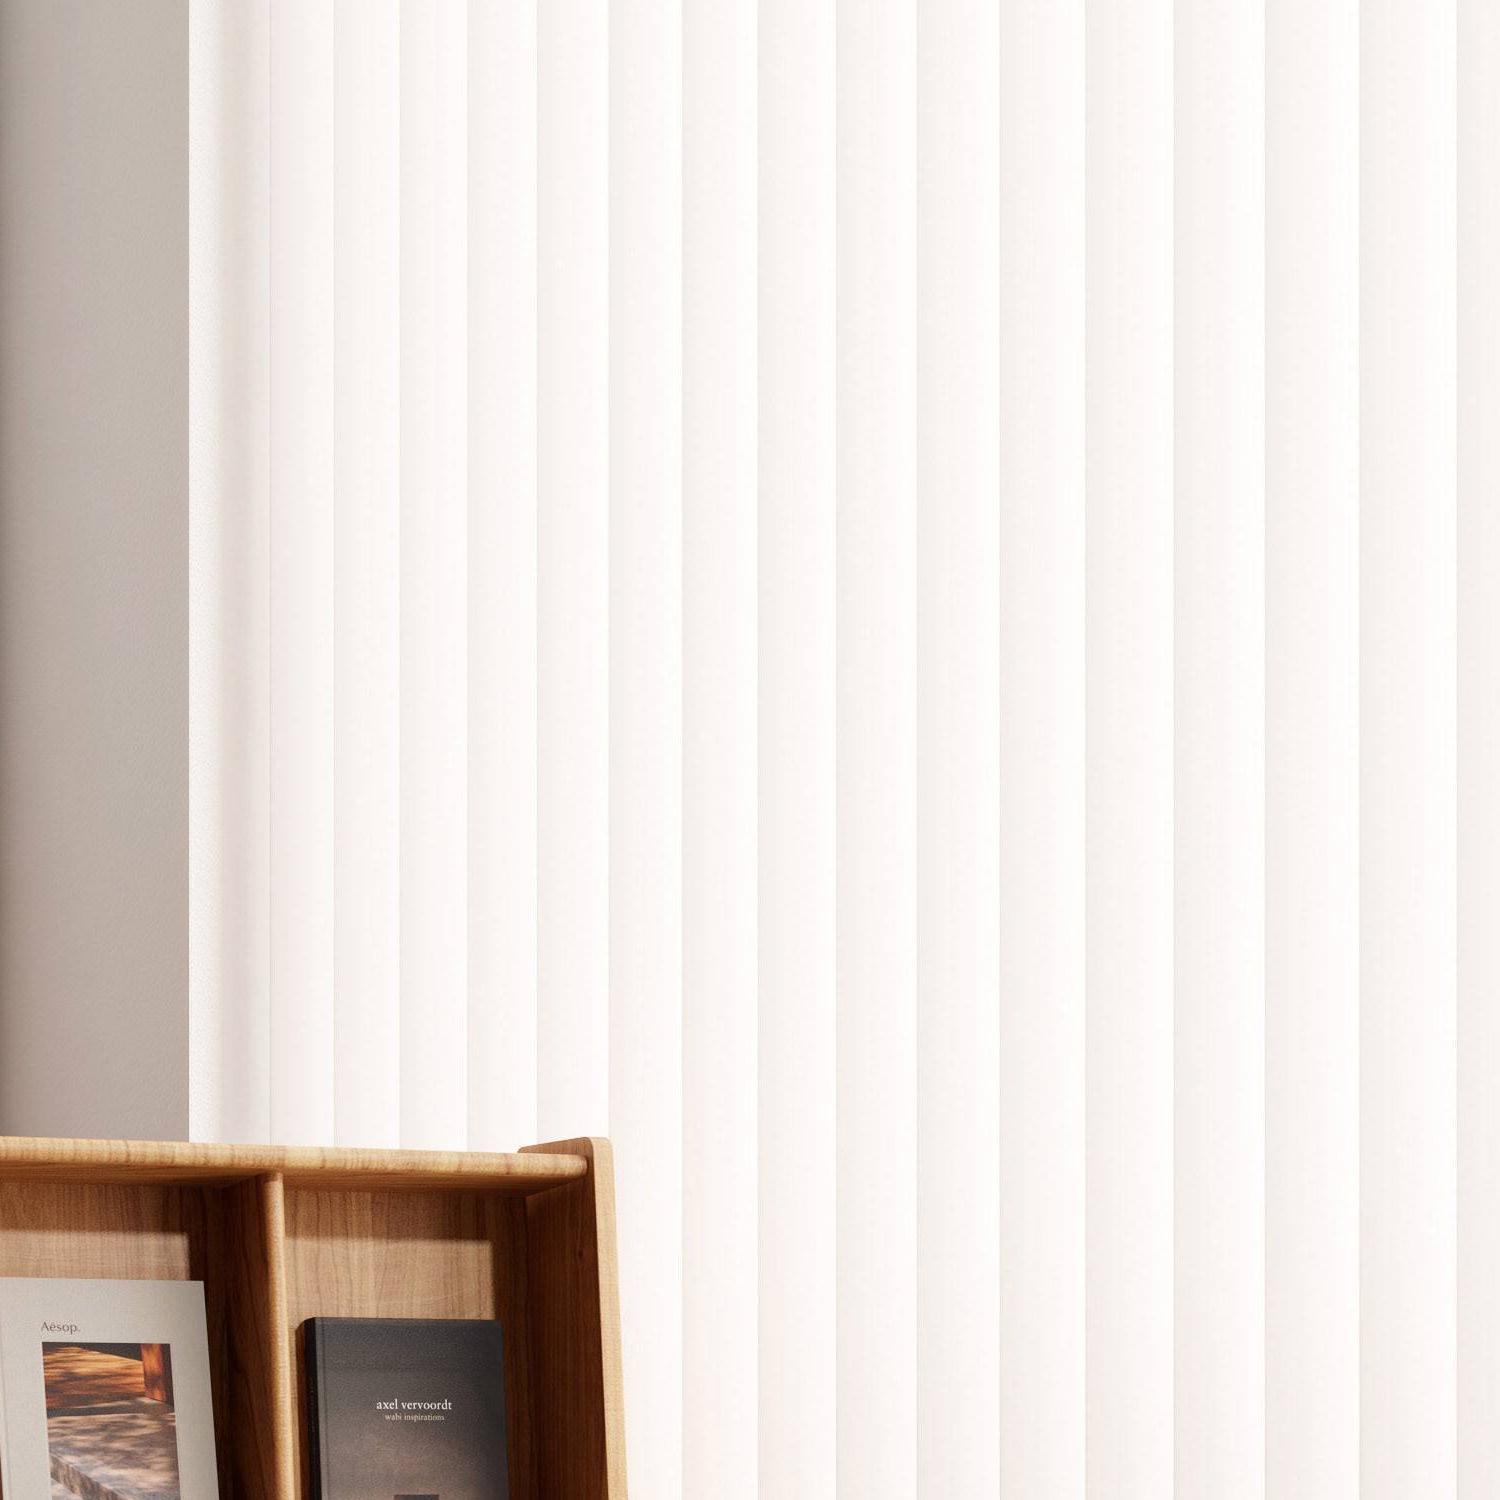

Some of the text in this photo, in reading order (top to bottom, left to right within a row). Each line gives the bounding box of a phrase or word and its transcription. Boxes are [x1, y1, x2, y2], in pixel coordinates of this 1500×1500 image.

[376, 1398, 452, 1410] axel vervoordt
[403, 1412, 445, 1423] inspirations
